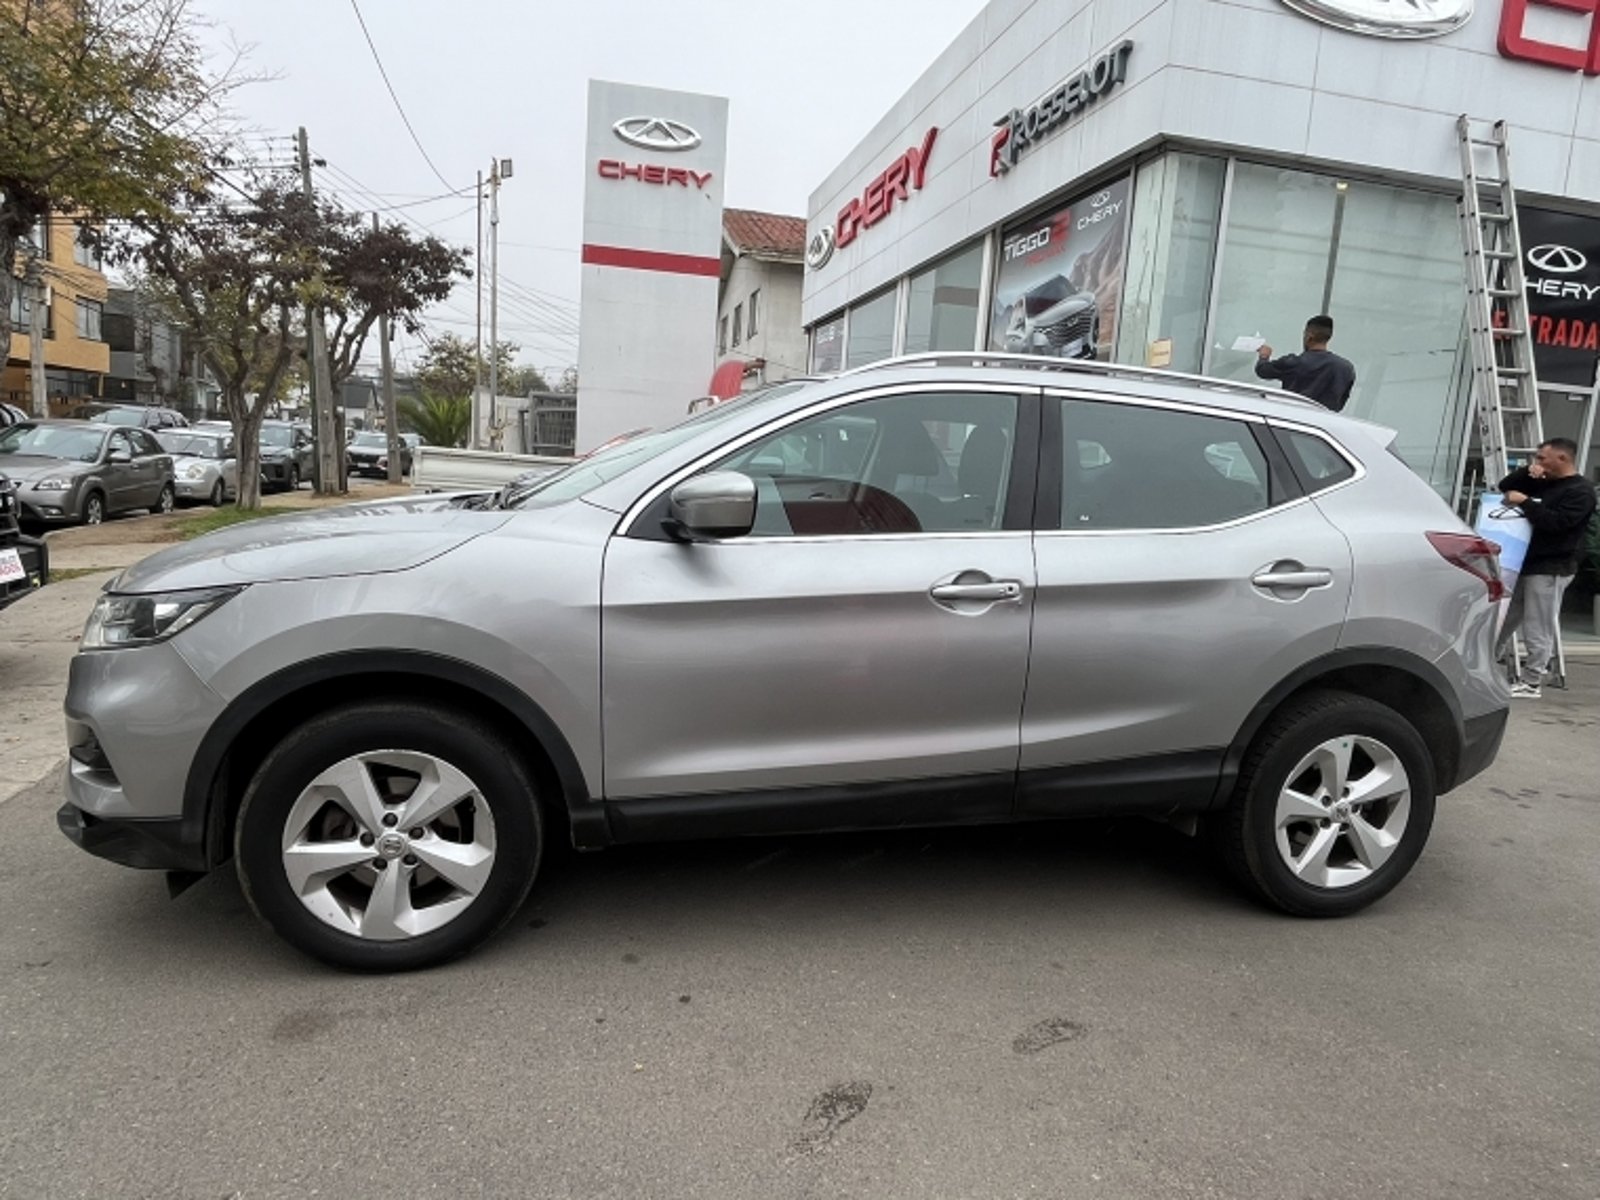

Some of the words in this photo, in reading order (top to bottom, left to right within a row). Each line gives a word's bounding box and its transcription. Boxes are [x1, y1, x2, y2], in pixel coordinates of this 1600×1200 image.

[598, 159, 713, 190] CHERY
[834, 125, 938, 249] CHERY
[1077, 199, 1123, 231] CHERY
[1004, 226, 1051, 262] TIGGO
[1502, 276, 1600, 300] HERY
